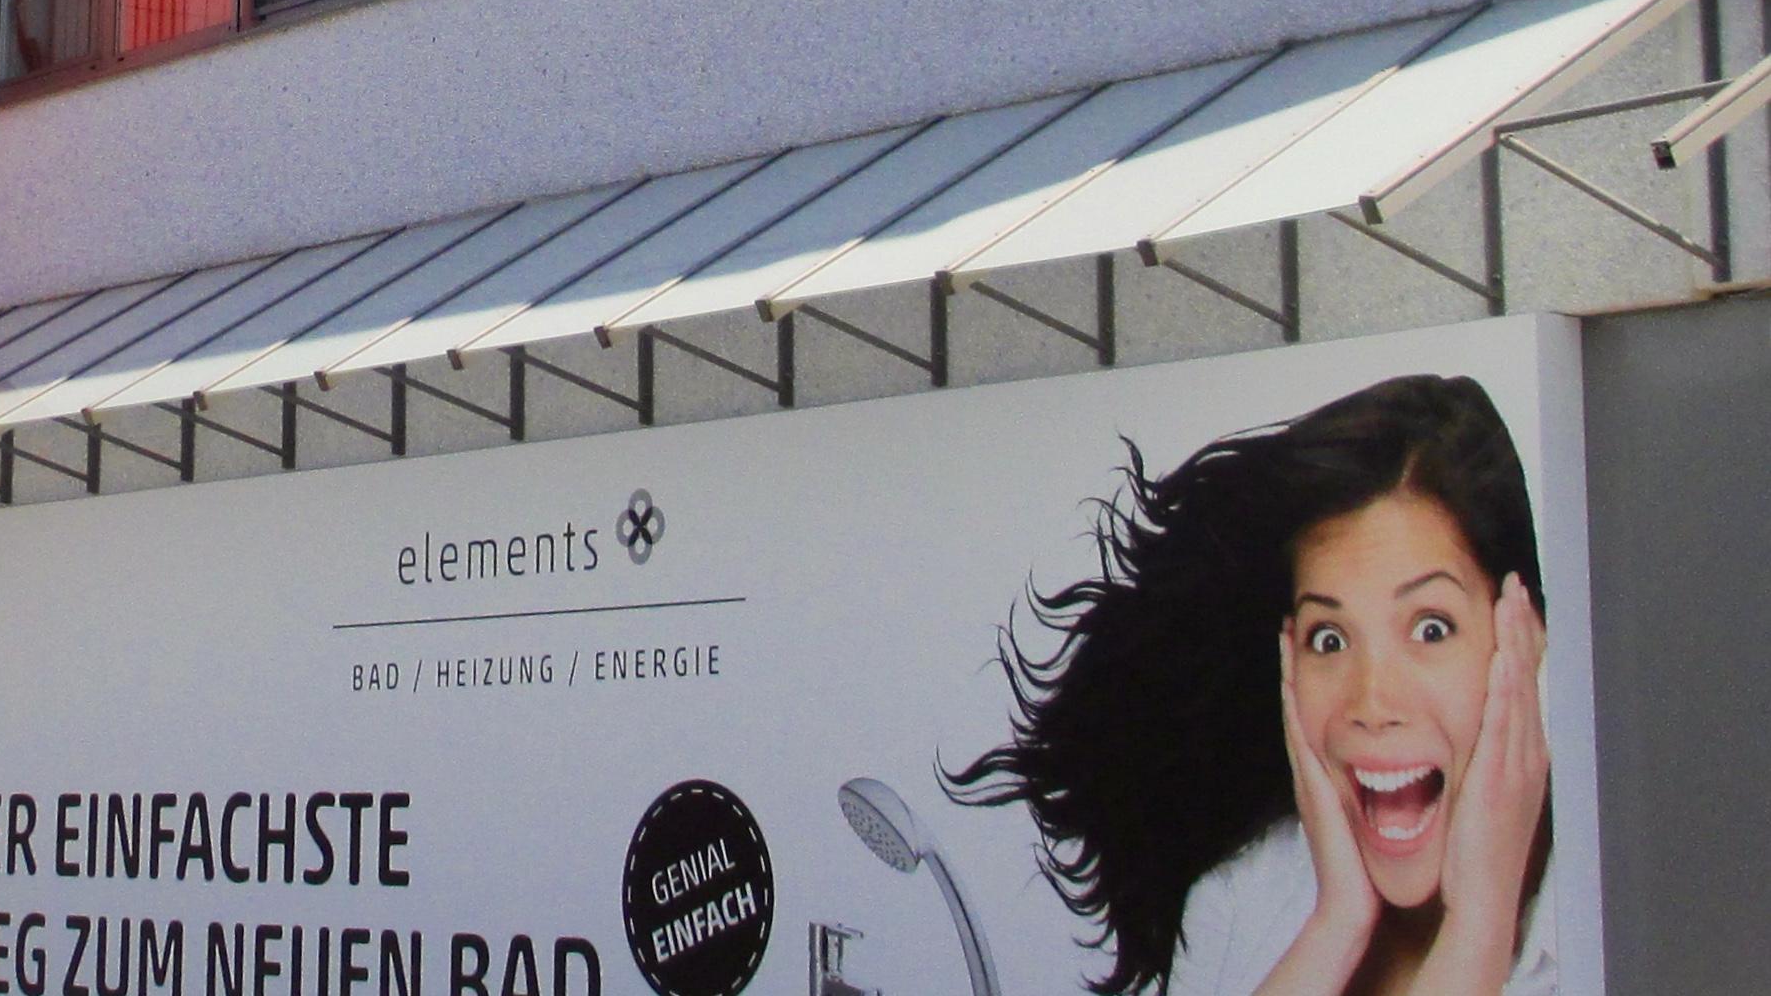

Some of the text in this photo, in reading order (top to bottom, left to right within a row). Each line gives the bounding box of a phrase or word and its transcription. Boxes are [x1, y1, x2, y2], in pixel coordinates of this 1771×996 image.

[397, 521, 600, 586] elements
[352, 661, 401, 691] BAD
[436, 654, 554, 688] HEIZUNG
[594, 645, 721, 681] ENERGIE
[54, 791, 412, 887] EINFACHSTE
[651, 838, 736, 905] GENIAL
[62, 914, 184, 996] ZUM
[206, 921, 423, 996] NEUEN
[449, 932, 603, 996] BAD
[651, 881, 757, 964] EINFACH
